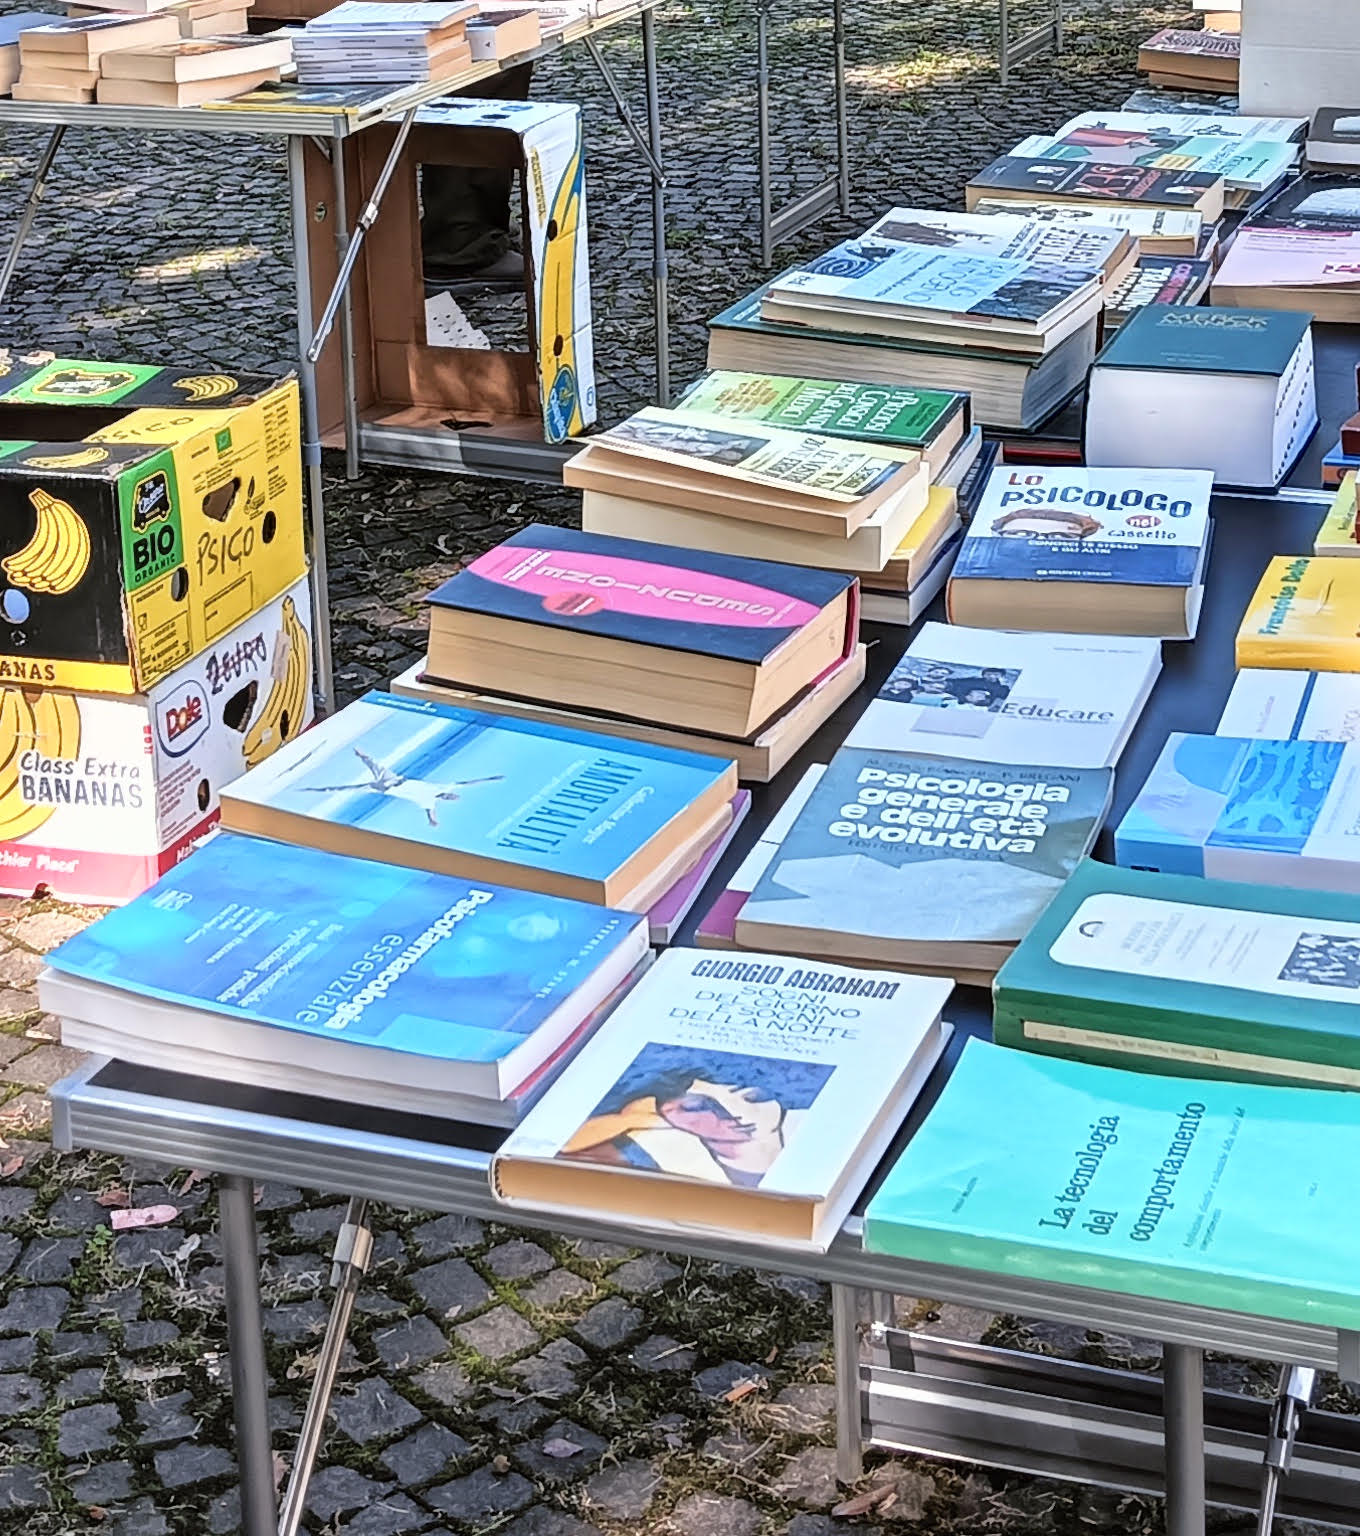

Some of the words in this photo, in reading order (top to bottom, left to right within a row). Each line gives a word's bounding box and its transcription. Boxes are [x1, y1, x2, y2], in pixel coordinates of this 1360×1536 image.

[1072, 164, 1145, 197] SEX
[1008, 472, 1044, 487] LO
[999, 486, 1193, 518] PSICOLOGO
[1107, 528, 1177, 540] cassetto
[1129, 515, 1156, 528] nel
[132, 524, 175, 570] BIO
[196, 526, 255, 586] PSICO
[134, 553, 176, 583] ORGANIC
[1257, 583, 1296, 636] Françoise
[165, 694, 202, 738] Dole
[1001, 702, 1115, 722] Educare
[20, 752, 74, 775] Class
[84, 757, 140, 780] Extra
[22, 774, 142, 809] BANANAS
[855, 767, 1070, 804] Psicologia
[496, 757, 644, 856] AMORTALITÀ
[839, 802, 862, 819] e
[879, 801, 1048, 838] dell'età
[857, 787, 1049, 820] generale
[828, 820, 1036, 855] evolutiva
[323, 889, 495, 1030] Psicofarmacologia
[295, 933, 404, 1024] essenziale
[691, 958, 785, 985] GIORGIO
[784, 968, 901, 1000] ABRAHAM
[739, 985, 827, 1005] SOGNI
[669, 1007, 758, 1028] DELLA
[695, 990, 739, 1005] DEL
[752, 998, 861, 1020] GIORNO
[1040, 1194, 1075, 1231] La
[1069, 1113, 1120, 1203] tecnologia
[1129, 1101, 1206, 1242] comportamento
[1082, 1209, 1119, 1236] del
